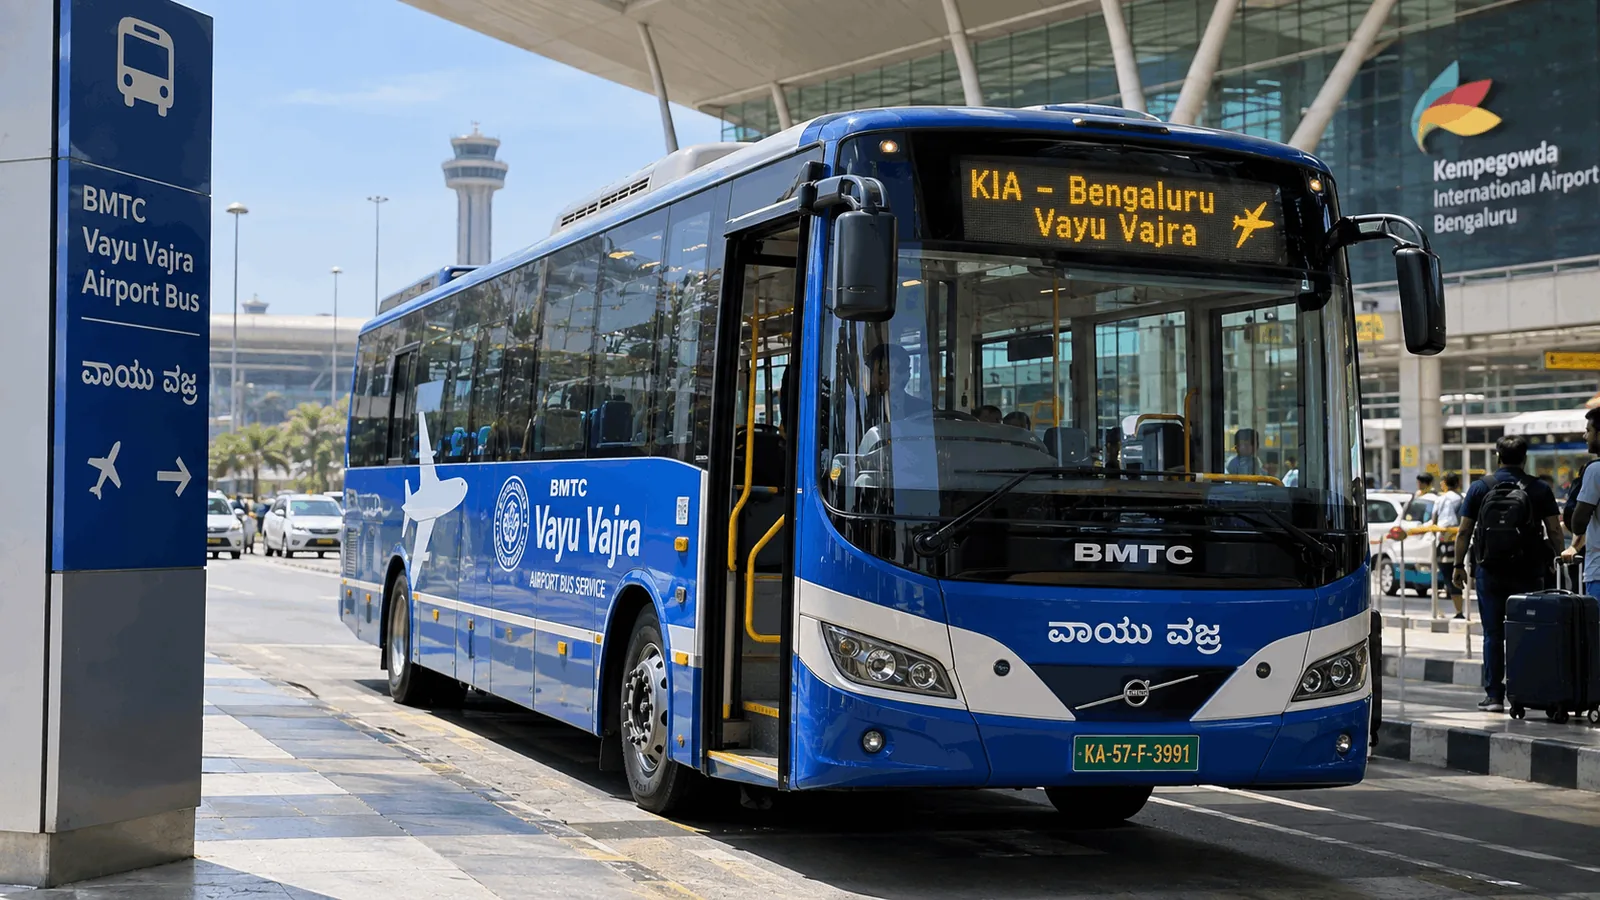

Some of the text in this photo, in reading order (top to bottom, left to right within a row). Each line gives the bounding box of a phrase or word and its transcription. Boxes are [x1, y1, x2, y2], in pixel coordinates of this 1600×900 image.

[1433, 140, 1559, 182] Kempegowda
[83, 185, 147, 224] BMTC
[971, 169, 1022, 201] KIA
[1069, 175, 1215, 214] Bengaluru
[1433, 165, 1600, 208] International Airport
[1035, 207, 1197, 248] Vayu Vajra
[1433, 206, 1518, 236] Bengaluru
[82, 226, 194, 275] Vayu Vajra
[81, 269, 200, 313] Airport Bus
[81, 359, 198, 406] ವಾಯು ವಜ್ರ
[549, 478, 588, 498] BMTC
[535, 504, 581, 563] Vayu
[587, 504, 641, 569] Vajra
[1074, 543, 1193, 565] BMTC
[529, 571, 606, 598] AIRPORT BUS SERVICE
[1048, 616, 1222, 655] ವಾಯು ವಜ್ರ
[1084, 744, 1190, 764] KA-57-F-3991
